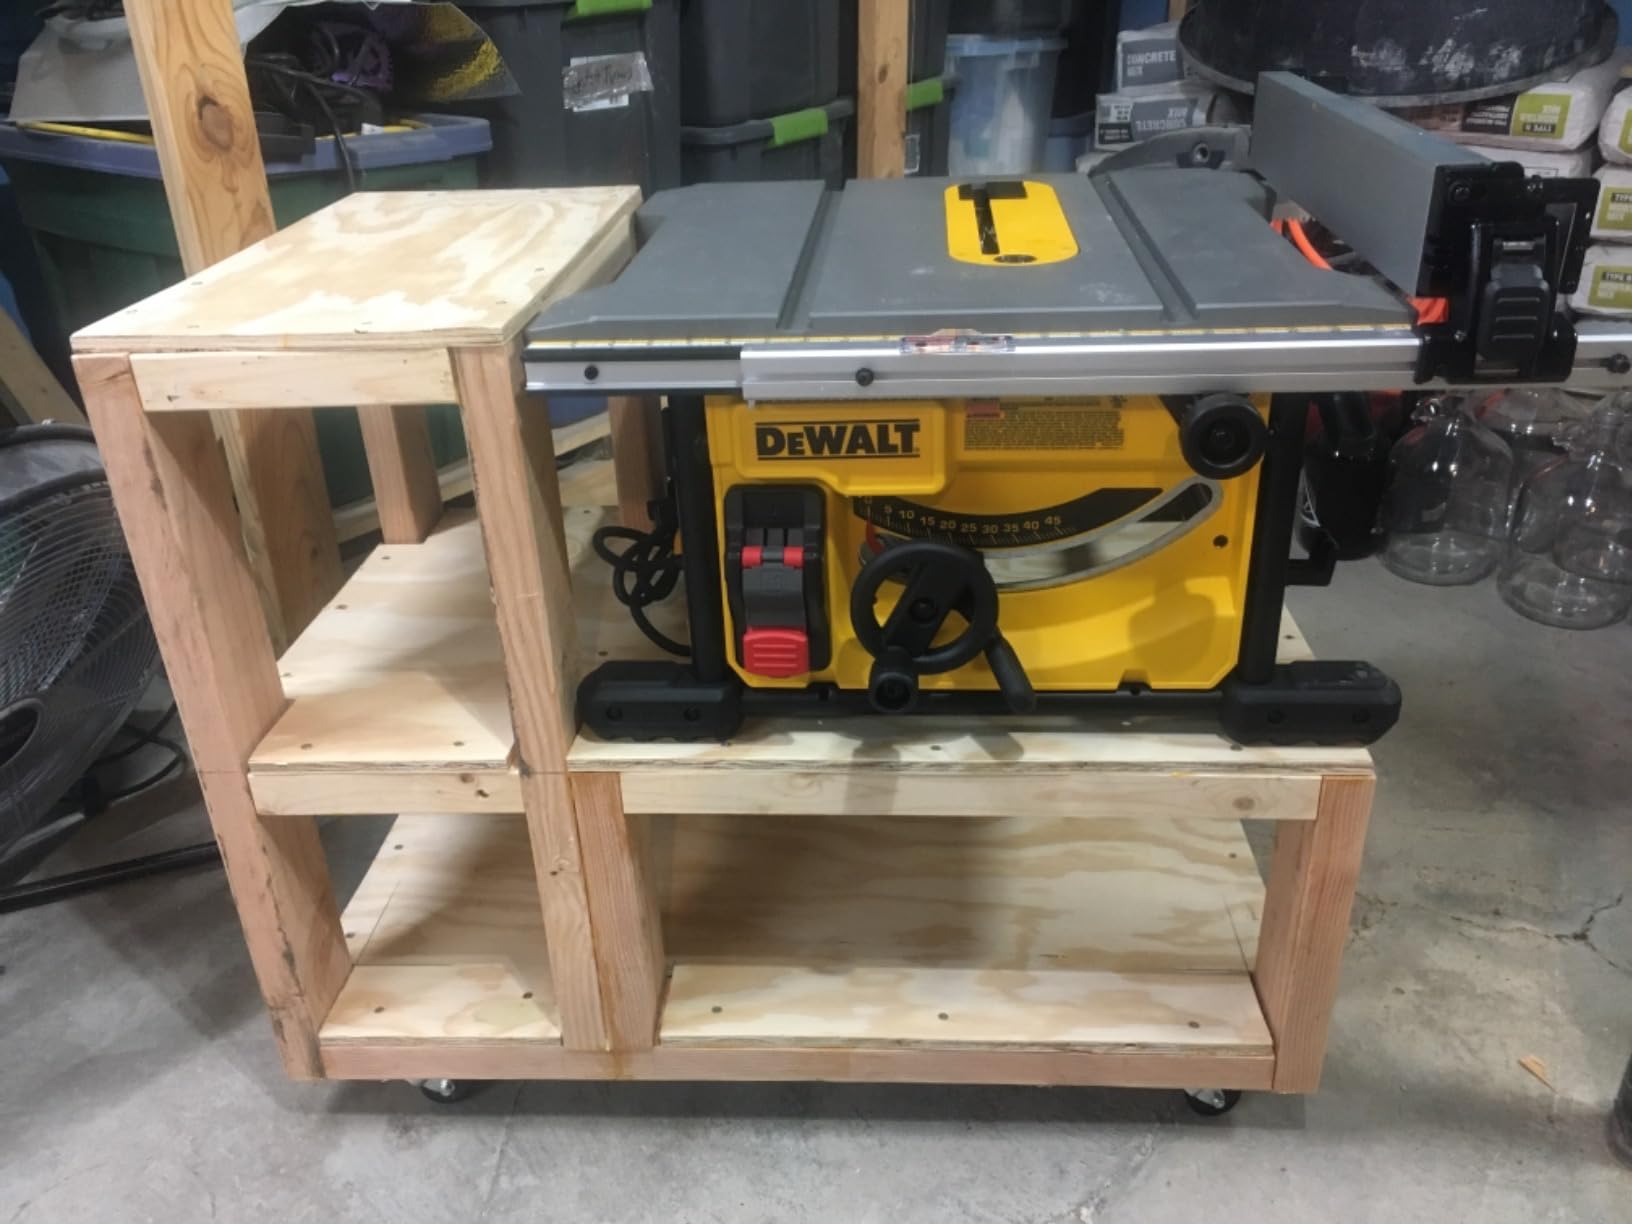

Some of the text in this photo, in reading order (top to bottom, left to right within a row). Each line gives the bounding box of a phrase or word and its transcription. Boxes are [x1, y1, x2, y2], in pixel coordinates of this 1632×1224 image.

[1127, 50, 1177, 65] CONCRETE
[899, 509, 915, 519] 10
[920, 516, 936, 526] 15
[940, 519, 957, 529] 20
[960, 522, 977, 533] 25
[981, 524, 999, 534] 30
[1003, 523, 1020, 533] 35
[1023, 520, 1040, 530] 40
[1044, 515, 1062, 526] 45
